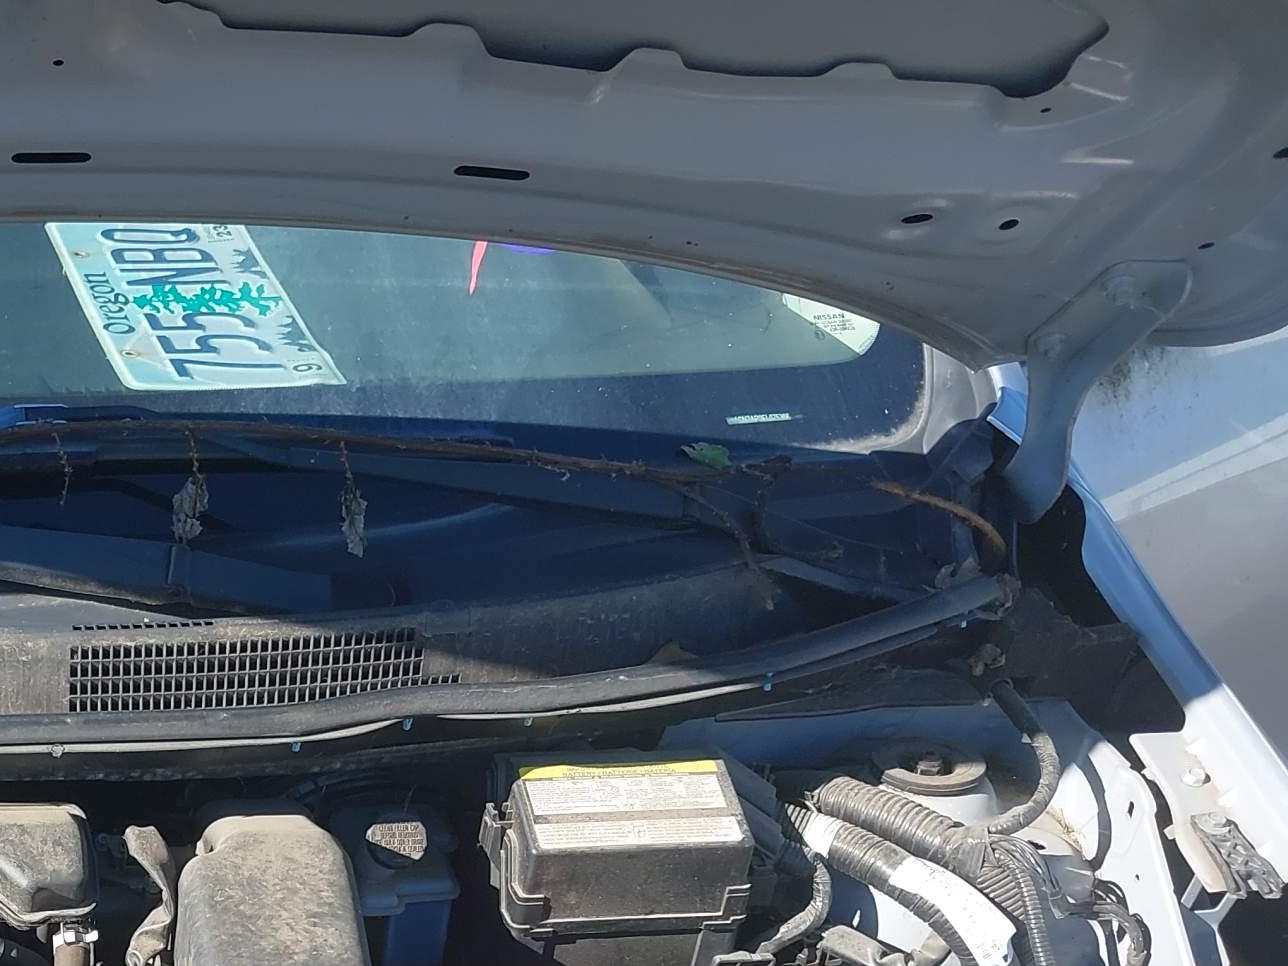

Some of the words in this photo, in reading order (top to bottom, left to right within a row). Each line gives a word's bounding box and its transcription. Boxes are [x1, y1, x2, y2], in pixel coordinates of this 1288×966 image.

[100, 228, 235, 287] NBQ
[212, 224, 233, 239] 23
[84, 272, 136, 335] Oregon
[143, 312, 288, 381] 755
[293, 362, 322, 374] 9
